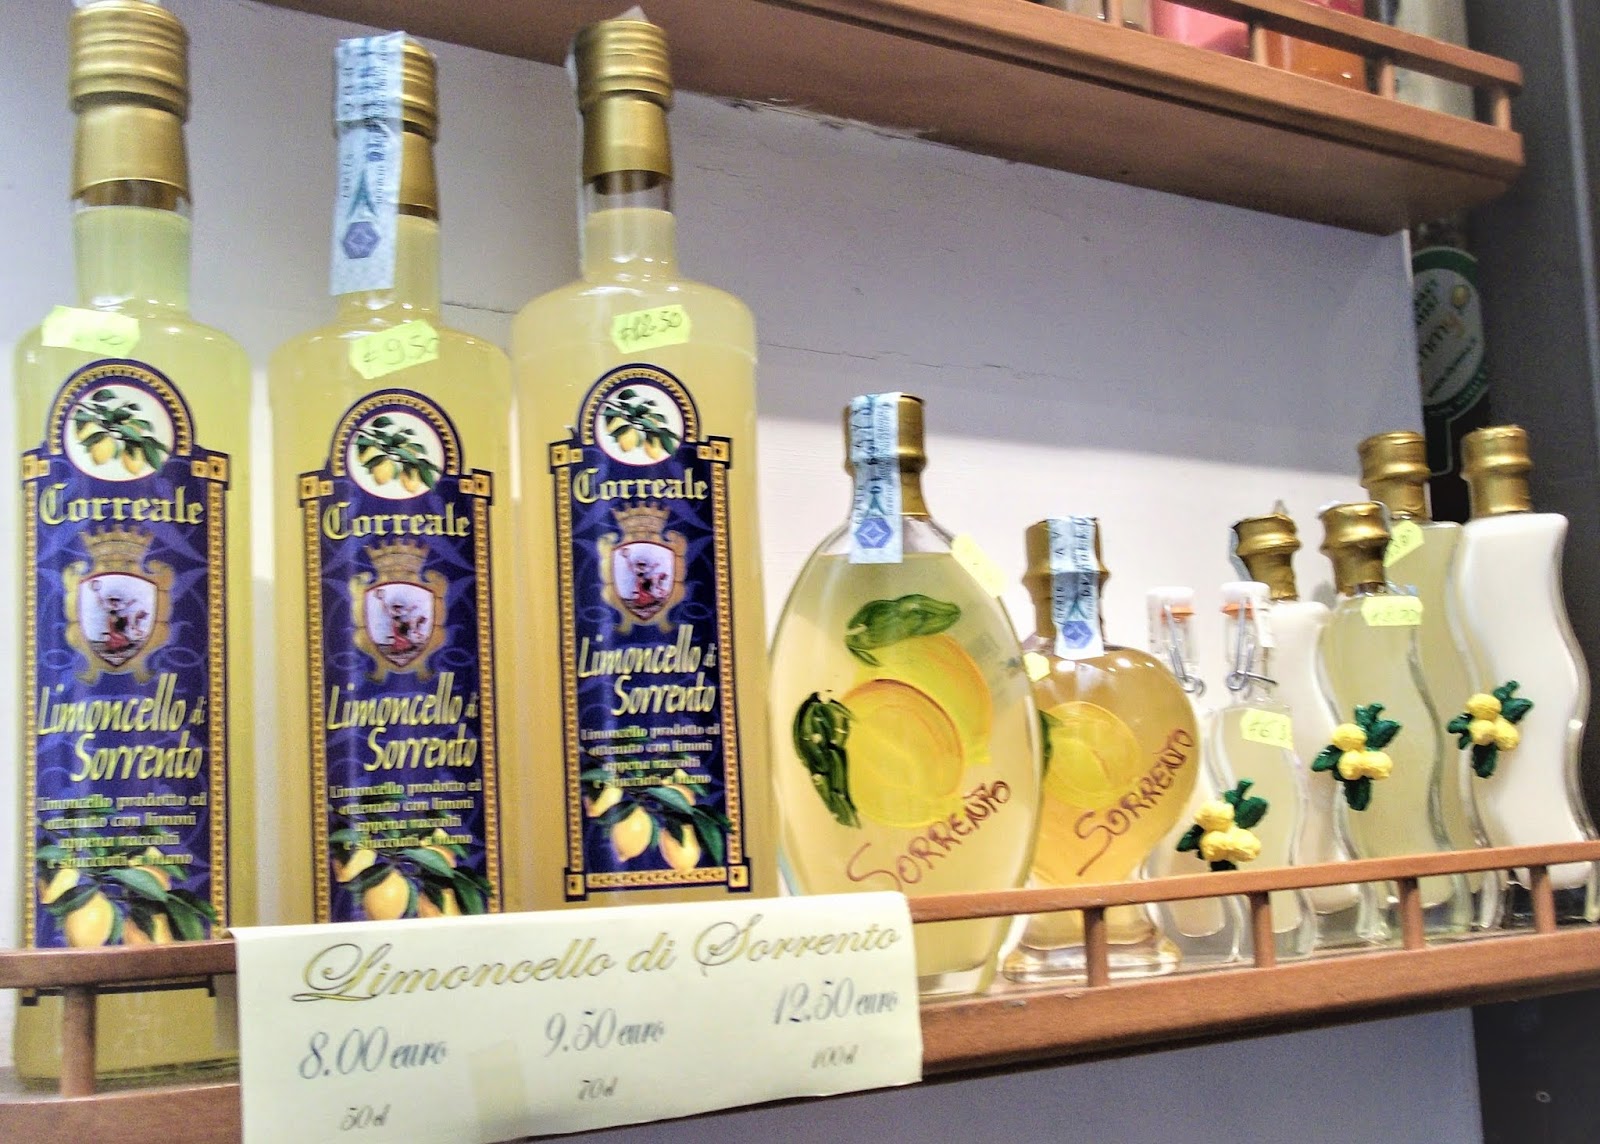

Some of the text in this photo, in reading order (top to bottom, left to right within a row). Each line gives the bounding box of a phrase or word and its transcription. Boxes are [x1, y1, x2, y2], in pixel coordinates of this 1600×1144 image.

[38, 483, 204, 525] Correale
[572, 467, 709, 504] Correale
[322, 502, 470, 540] Correale
[578, 624, 702, 678] Limoncello
[37, 673, 187, 735] Limoncello
[327, 672, 463, 730] Limoncello
[611, 672, 716, 716] Sorrento
[70, 730, 203, 782] Sorrento
[363, 723, 478, 772] Sorrento
[290, 913, 901, 1002] Limoncello di Sorrento
[774, 977, 855, 1025] 12.50
[299, 1026, 389, 1079] 8.00
[543, 1007, 617, 1058] 9.50
